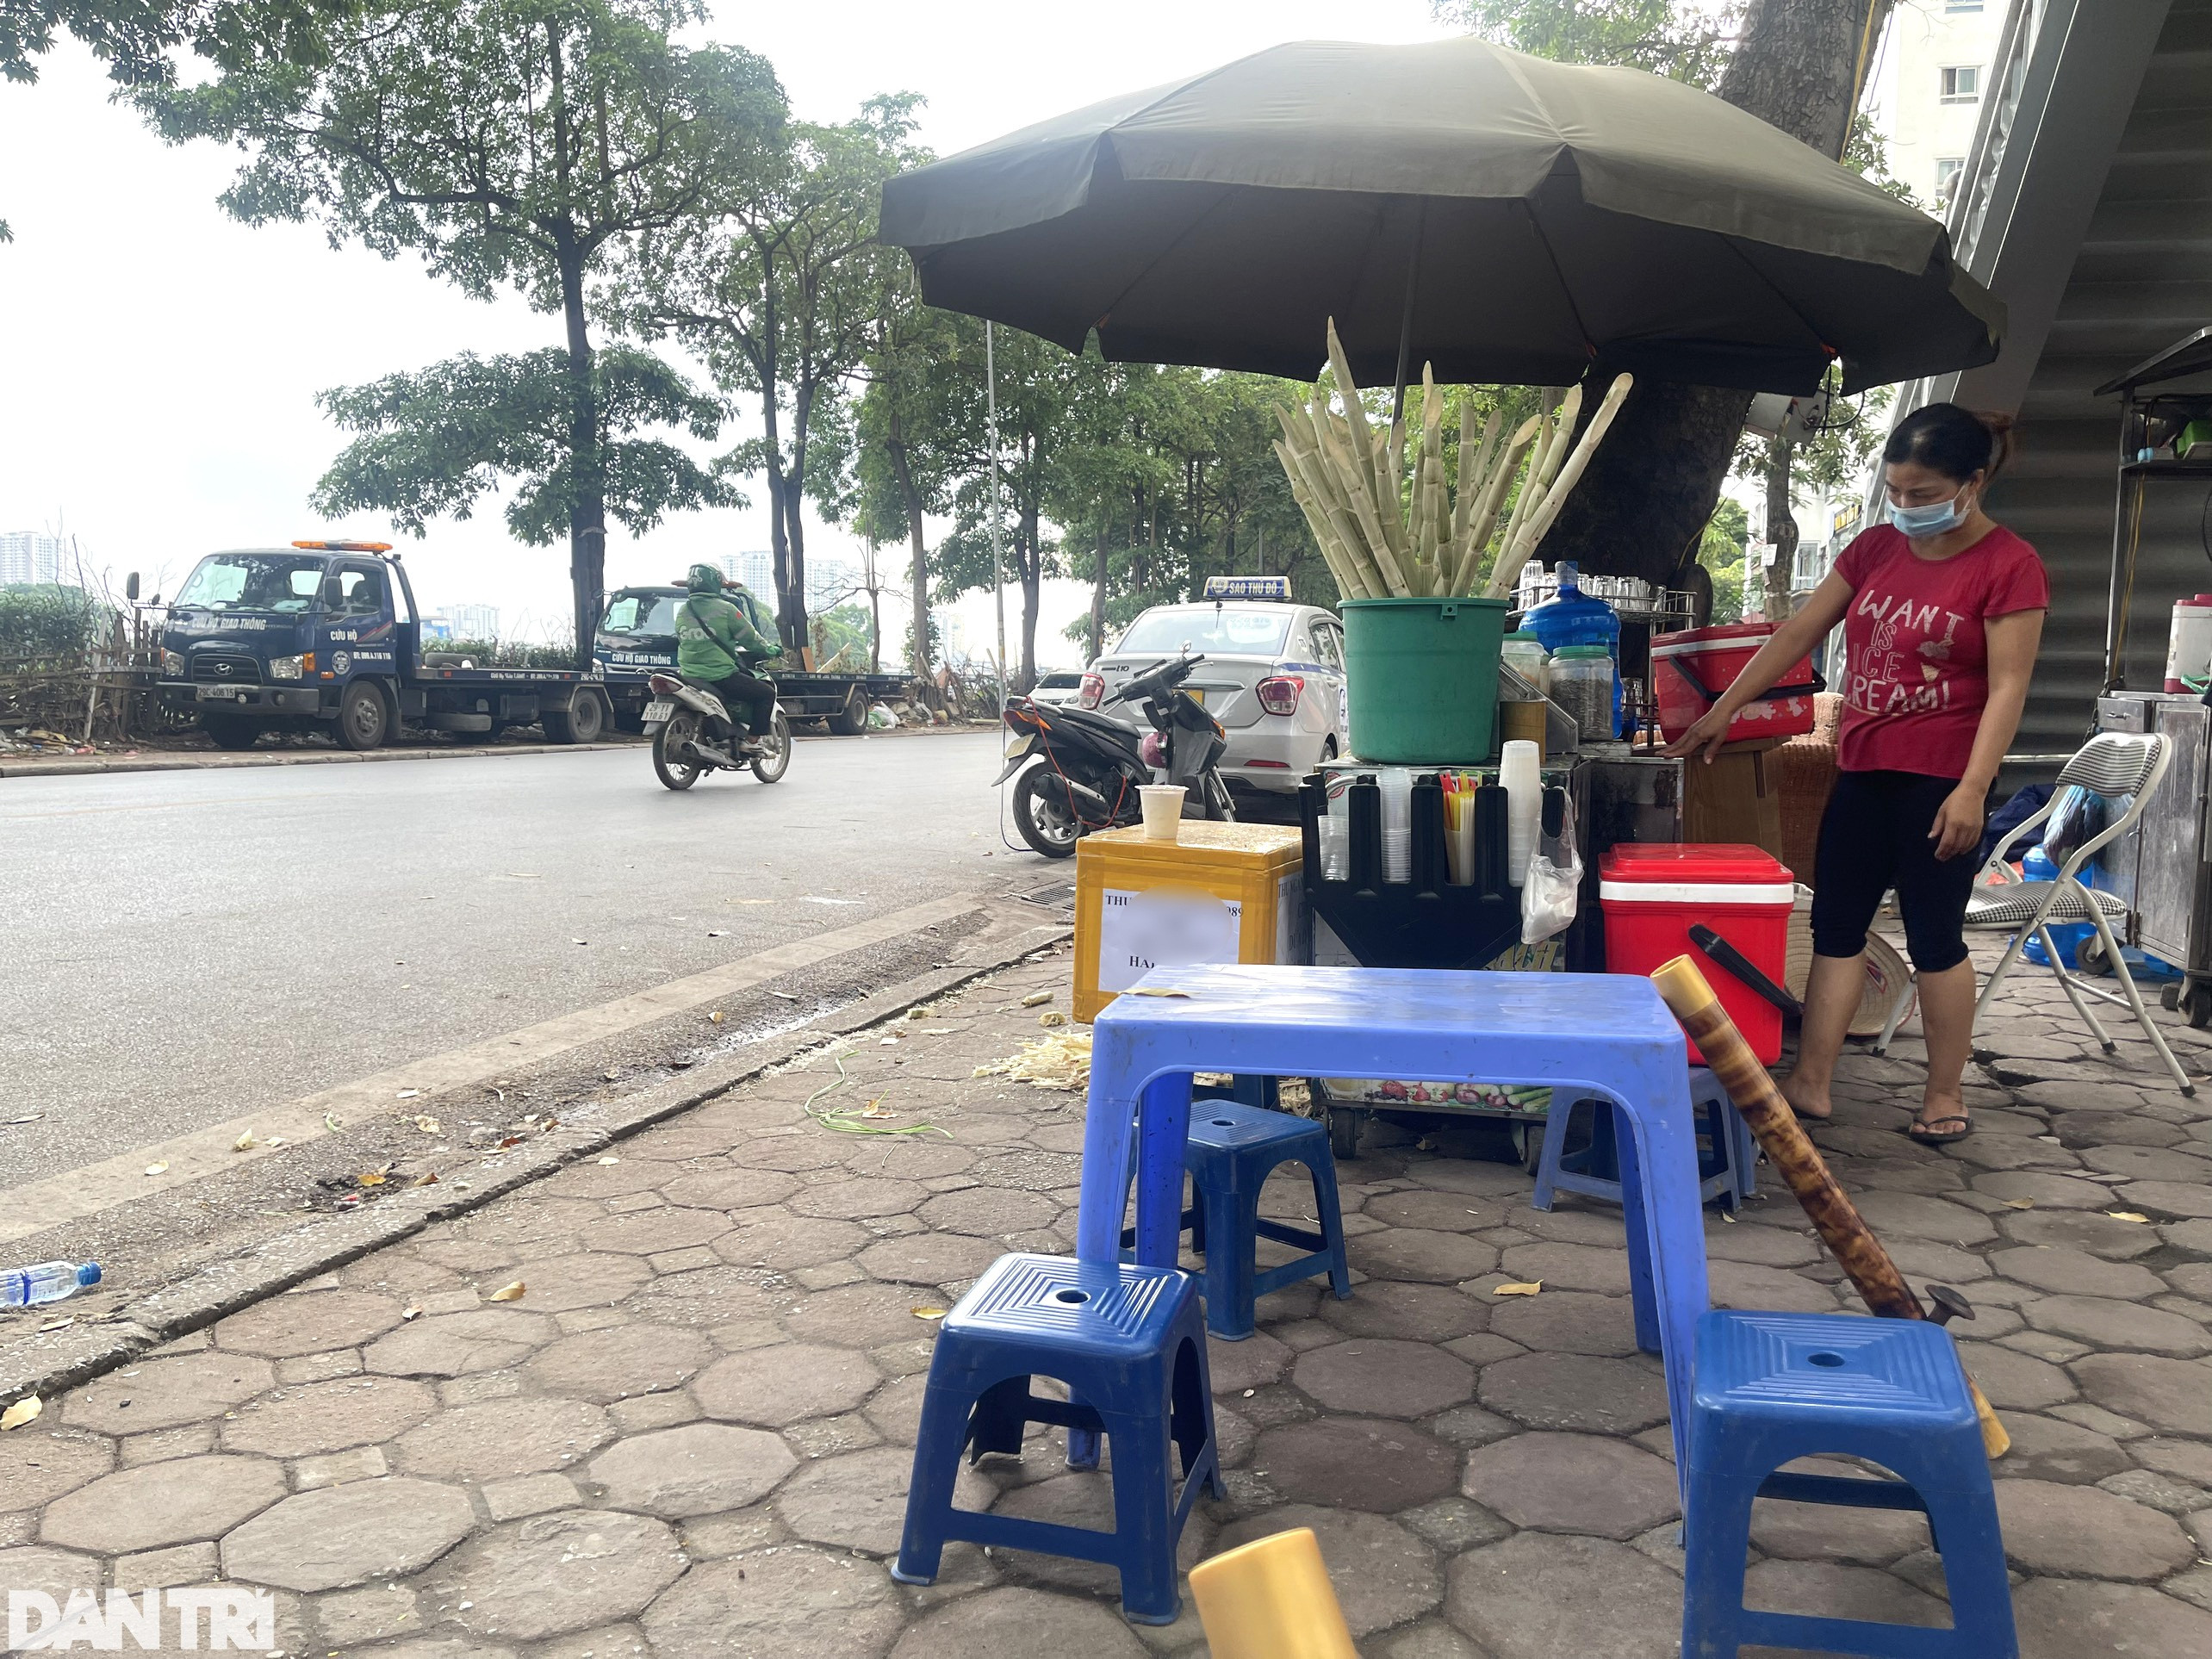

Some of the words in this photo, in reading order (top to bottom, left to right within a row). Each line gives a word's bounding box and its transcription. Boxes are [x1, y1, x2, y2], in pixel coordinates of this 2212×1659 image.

[1229, 582, 1246, 594] SAO
[1248, 580, 1264, 594] THỦ
[1265, 581, 1277, 594] ĐÔ
[1857, 590, 1965, 640] WANT
[221, 618, 239, 629] GIAO
[239, 617, 267, 631] THÔNG
[330, 629, 345, 641] CỨU
[347, 629, 357, 643] HỘ
[1871, 619, 1898, 649] IS
[612, 652, 624, 662] CỨU
[624, 653, 633, 665] HỘ
[634, 655, 649, 664] GIAO
[649, 654, 671, 665] THÔNG
[1852, 643, 1904, 683] ICE
